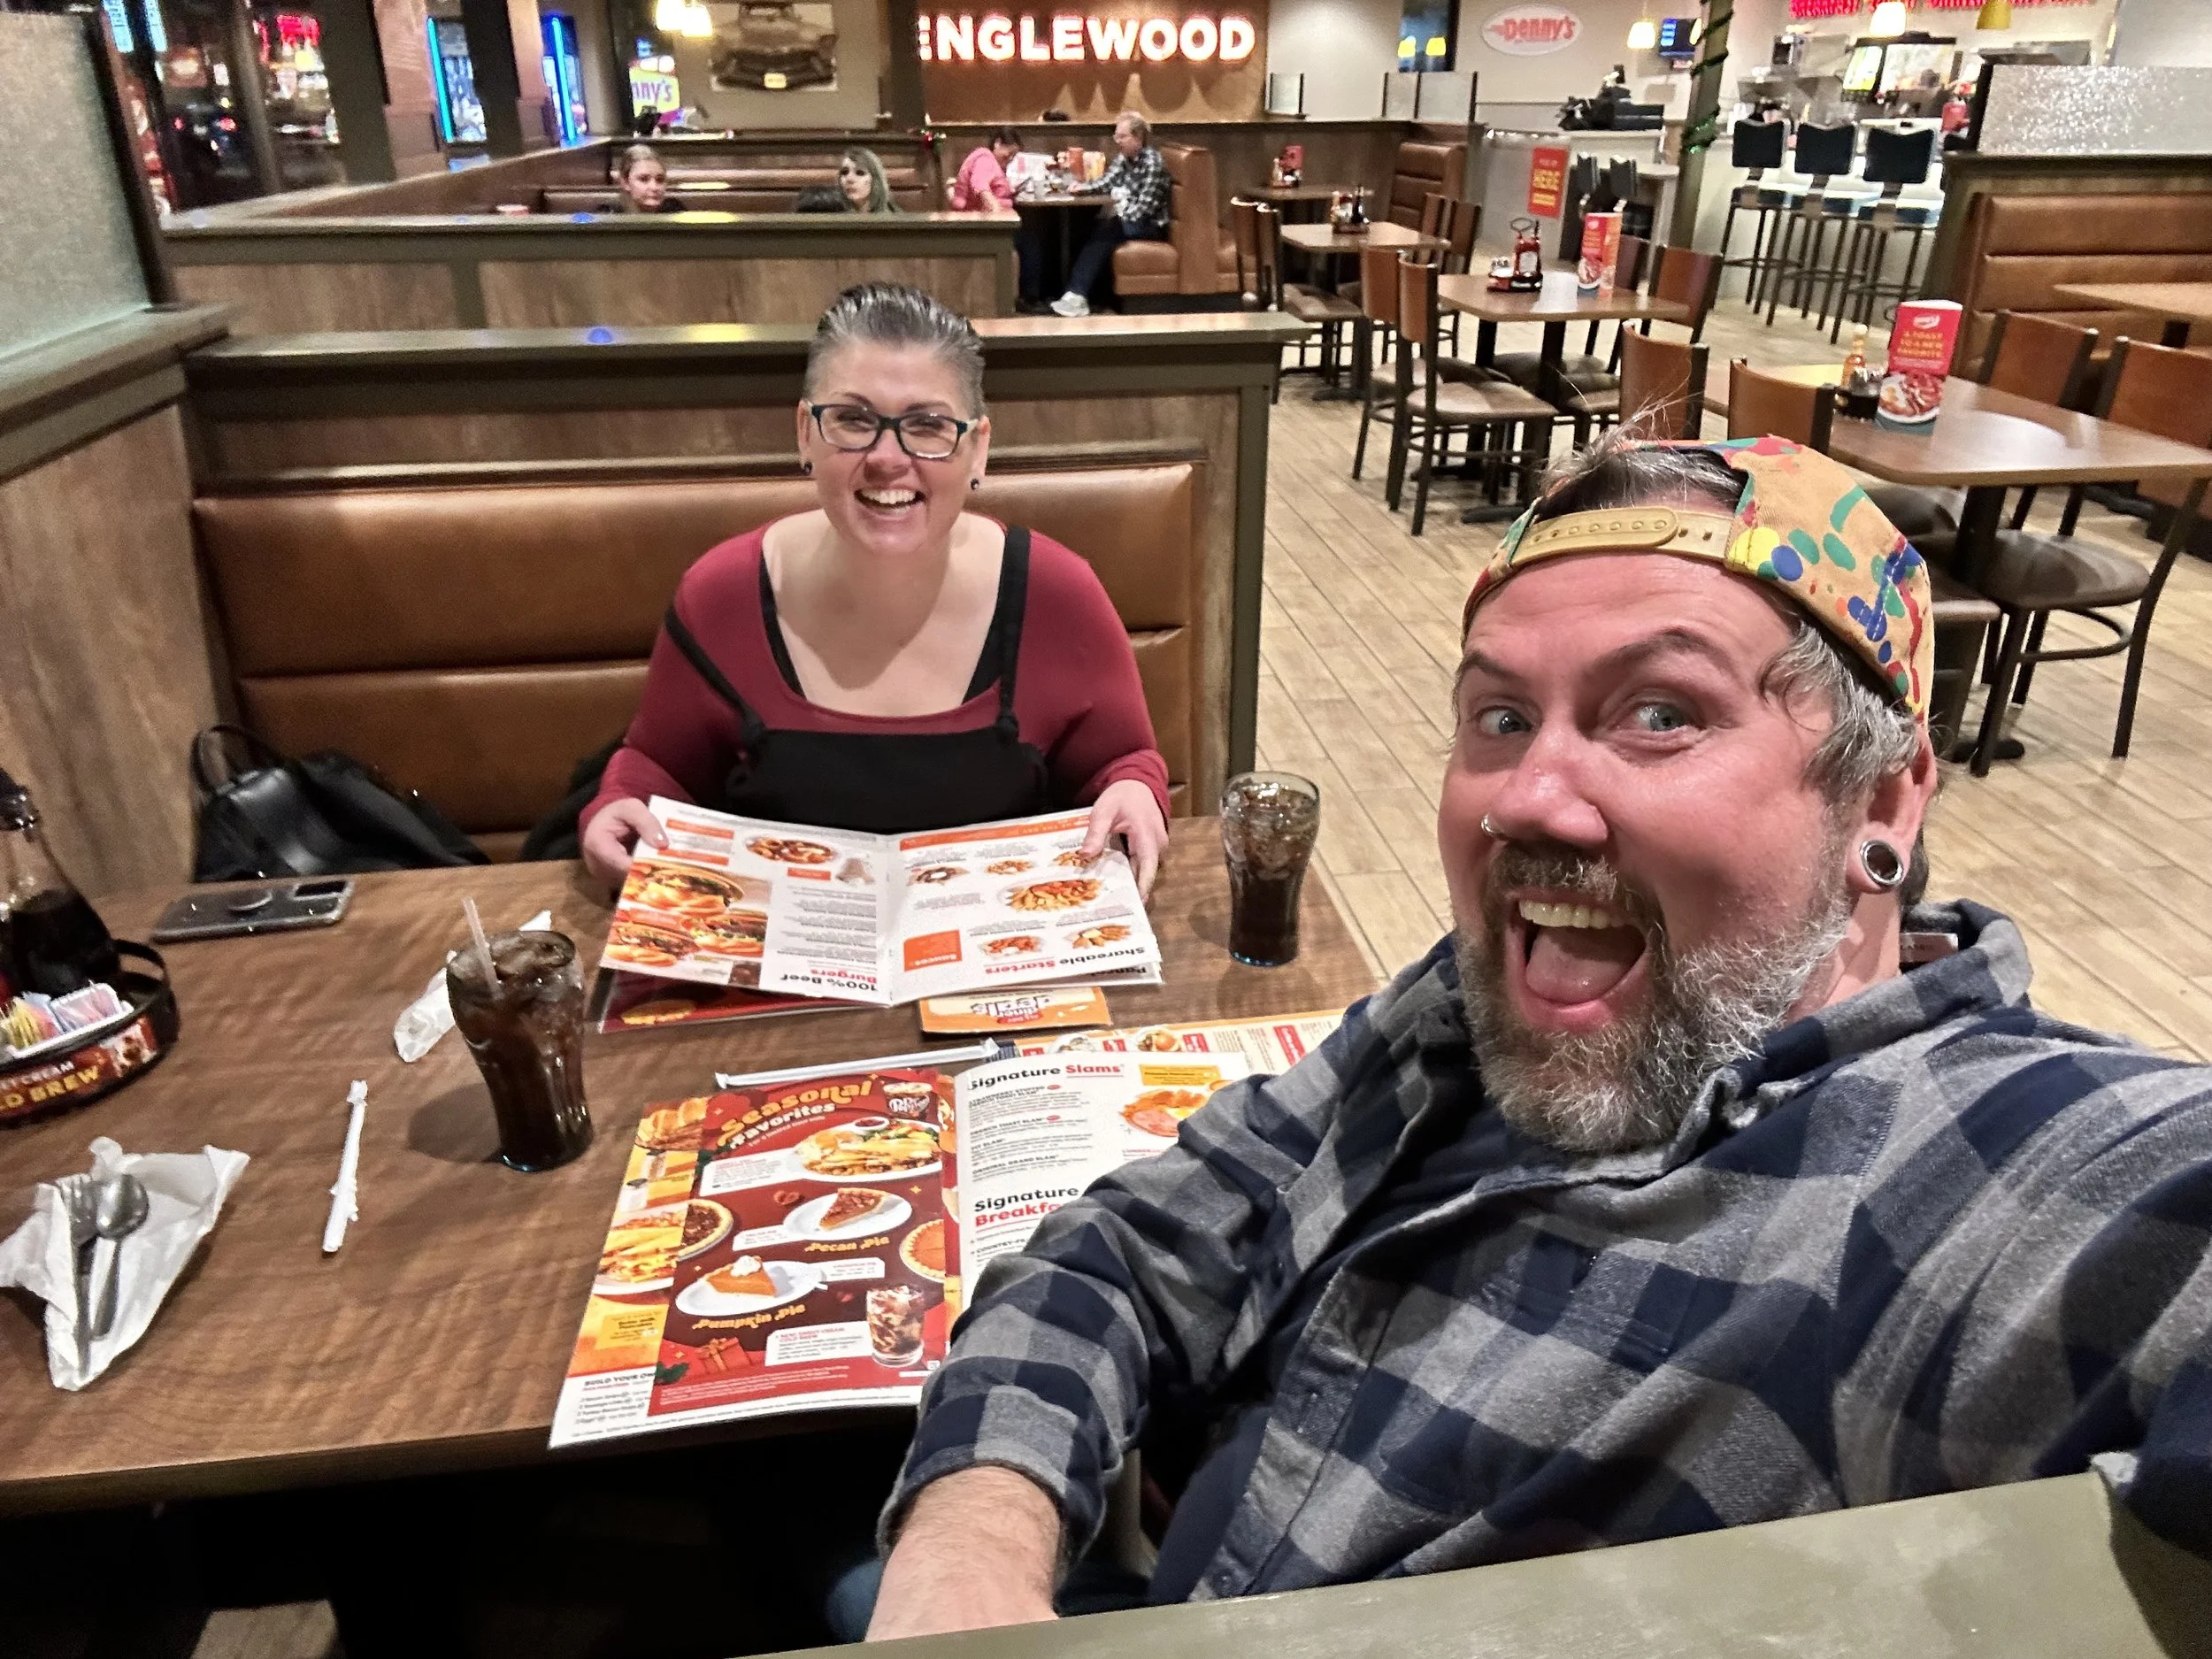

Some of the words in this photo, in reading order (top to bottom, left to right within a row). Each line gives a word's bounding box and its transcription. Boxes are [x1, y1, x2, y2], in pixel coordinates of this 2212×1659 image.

[1503, 16, 1575, 42] Denny's
[631, 78, 672, 104] nny's
[985, 960, 1056, 976] Starters
[1059, 946, 1145, 967] Shareable
[780, 973, 822, 985] Beef
[810, 969, 878, 982] Burgers
[826, 979, 878, 991] 100%
[971, 996, 1054, 1016] deals
[29, 1065, 99, 1102] BREW
[970, 1066, 1061, 1089] Signature
[1065, 1064, 1121, 1074] Slams
[717, 1080, 872, 1147] Seasonal
[729, 1102, 835, 1149] Favorites
[974, 1187, 1079, 1212] Signature
[976, 1202, 1062, 1227] Breakfa
[804, 1240, 856, 1253] Pecan
[861, 1235, 890, 1249] Pie
[691, 1313, 772, 1330] Pumpkin
[775, 1303, 806, 1321] Pie
